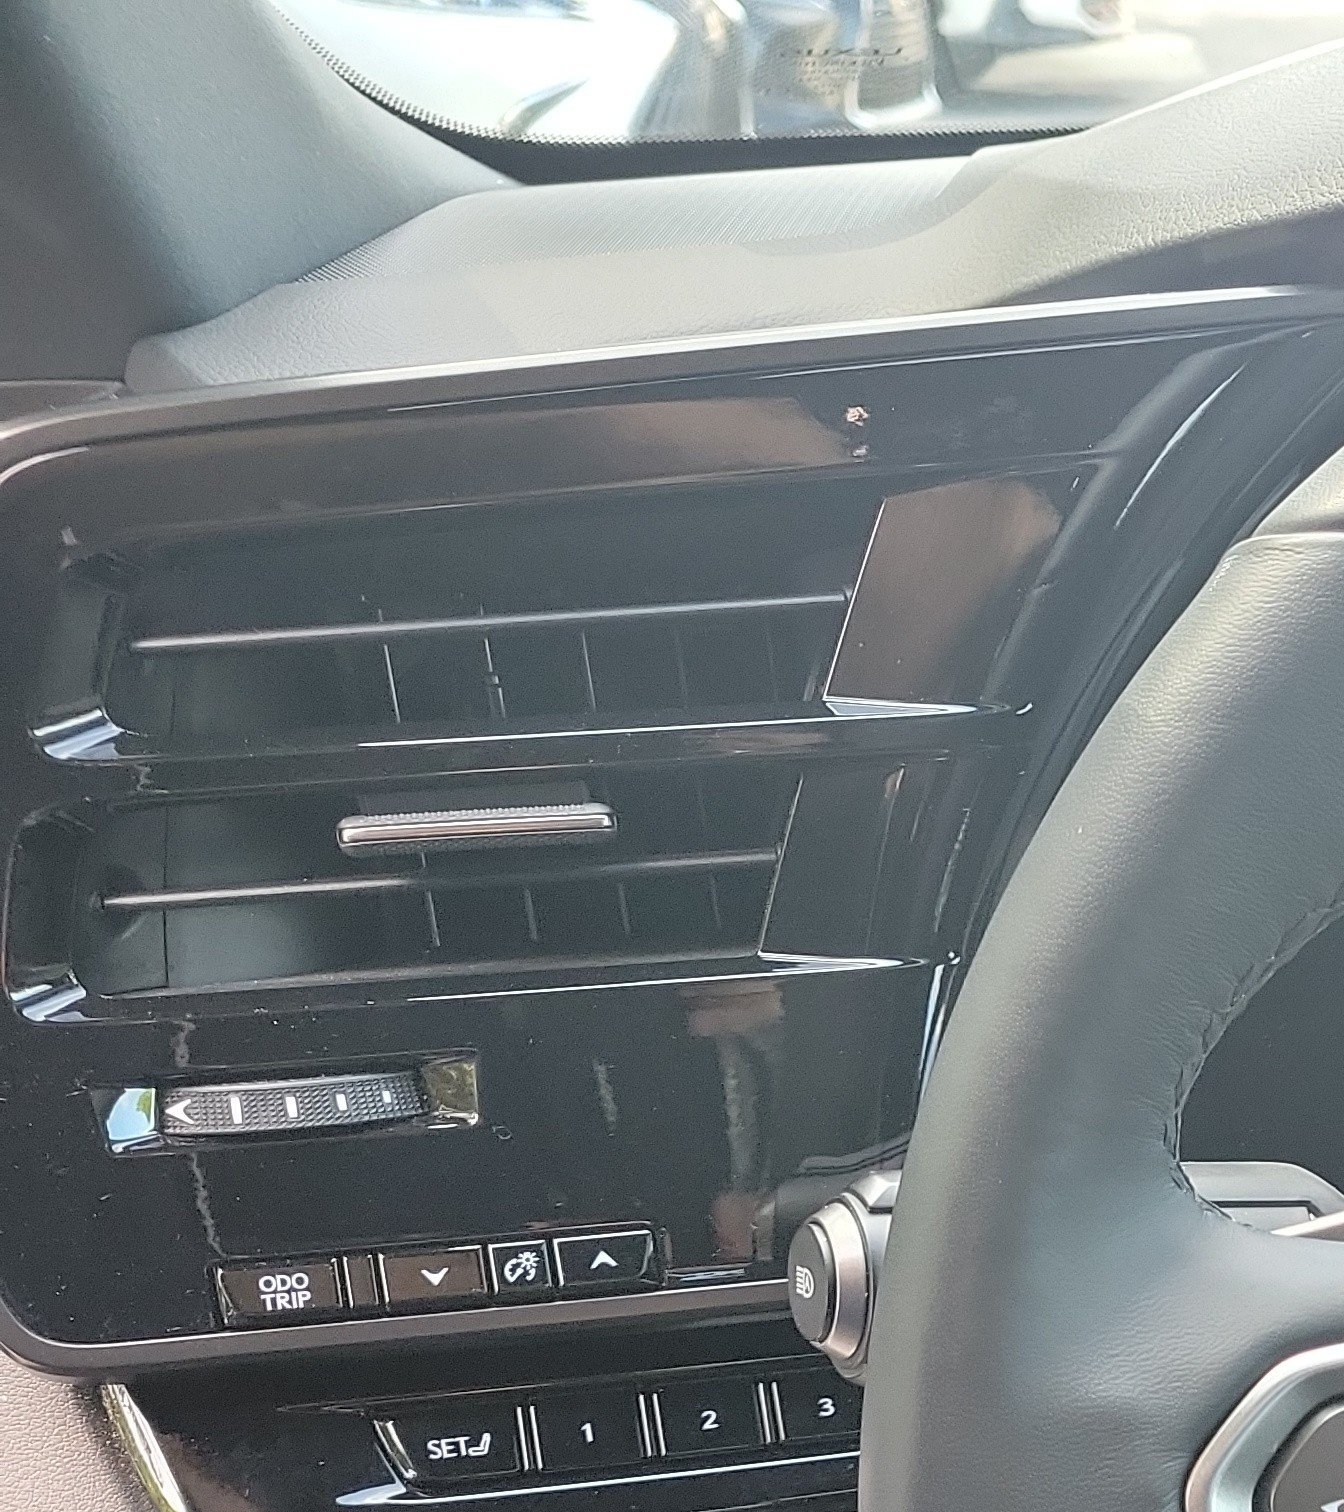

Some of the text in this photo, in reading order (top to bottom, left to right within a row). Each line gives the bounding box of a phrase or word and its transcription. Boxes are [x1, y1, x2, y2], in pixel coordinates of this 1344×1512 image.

[258, 1272, 309, 1293] ODO
[260, 1290, 312, 1311] TRIP
[816, 1397, 836, 1417] 3
[700, 1409, 720, 1430] 2
[580, 1422, 594, 1443] 1
[427, 1436, 470, 1460] SET
